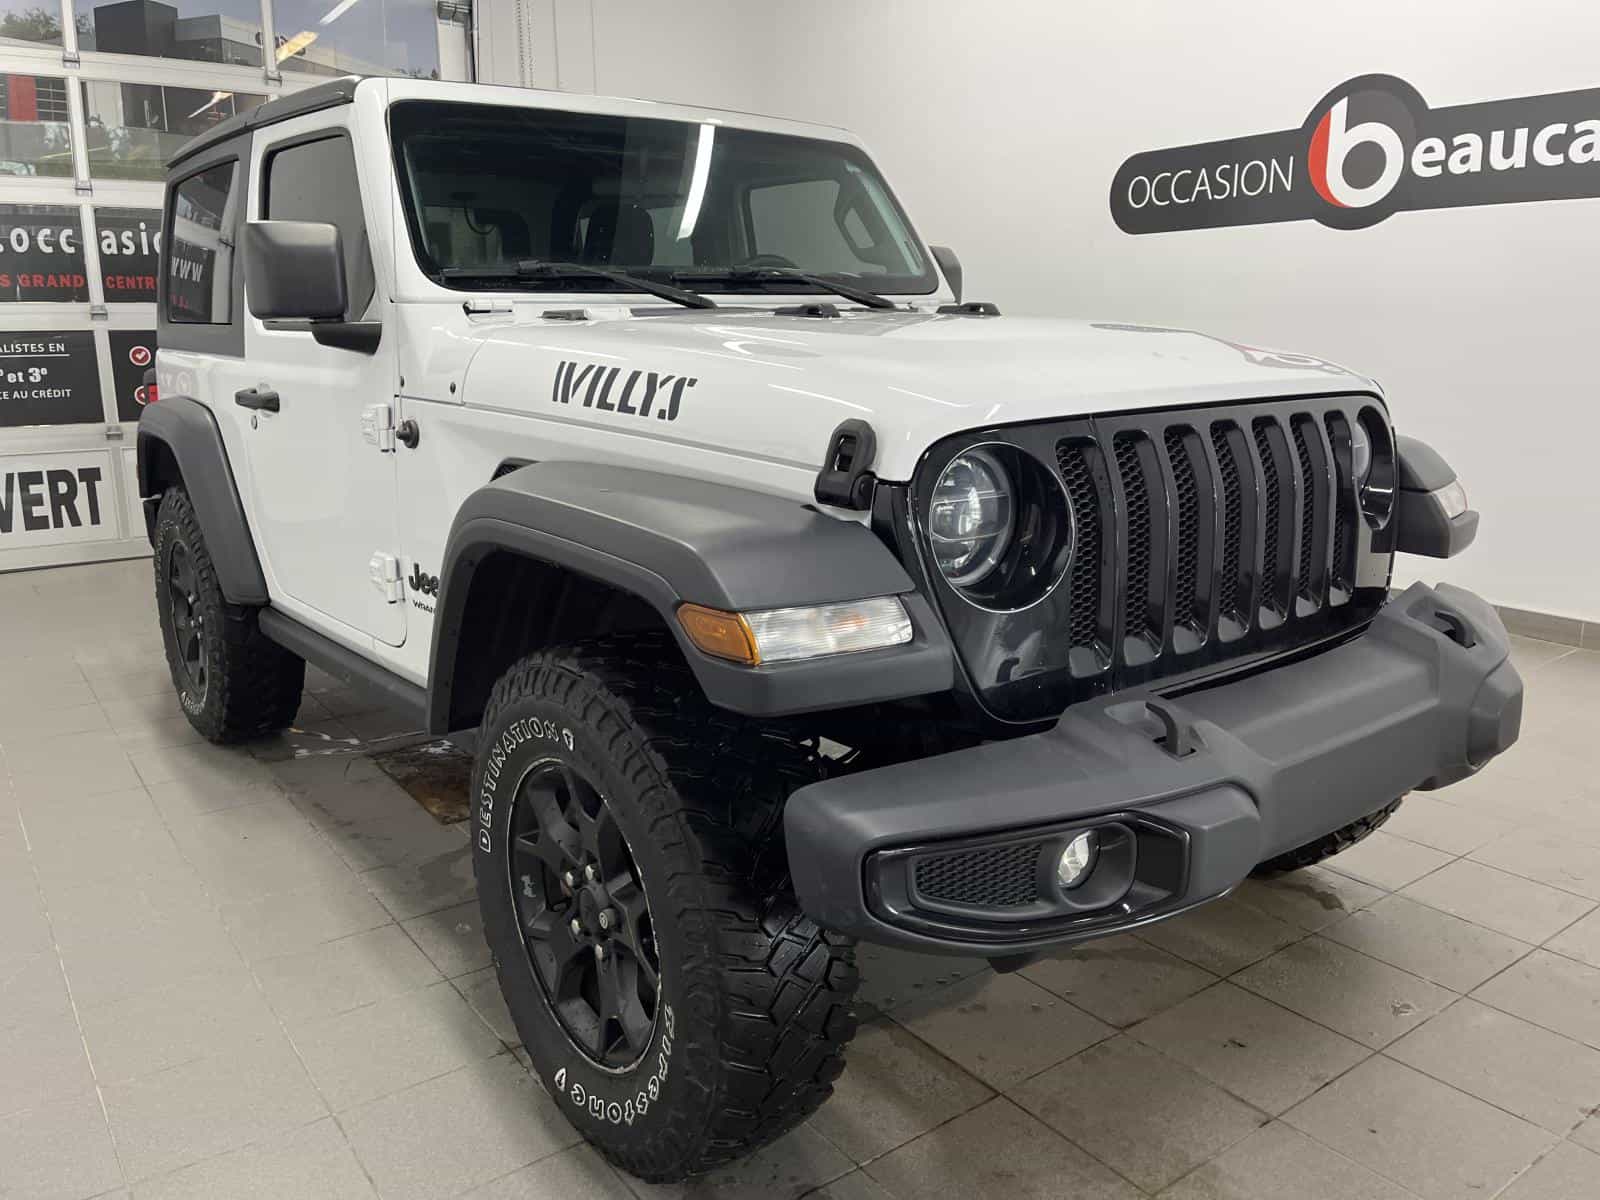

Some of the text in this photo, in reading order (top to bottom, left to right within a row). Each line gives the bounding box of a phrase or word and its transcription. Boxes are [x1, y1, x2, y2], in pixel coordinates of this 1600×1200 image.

[1127, 156, 1295, 209] OCCASION
[106, 275, 159, 289] CENTR
[49, 343, 65, 352] EN
[7, 371, 24, 383] et
[13, 390, 28, 399] AU
[32, 387, 72, 399] CRÉDIT
[552, 361, 698, 421] WILLYS
[408, 563, 439, 598] Jee
[479, 717, 559, 854] DESTINATION
